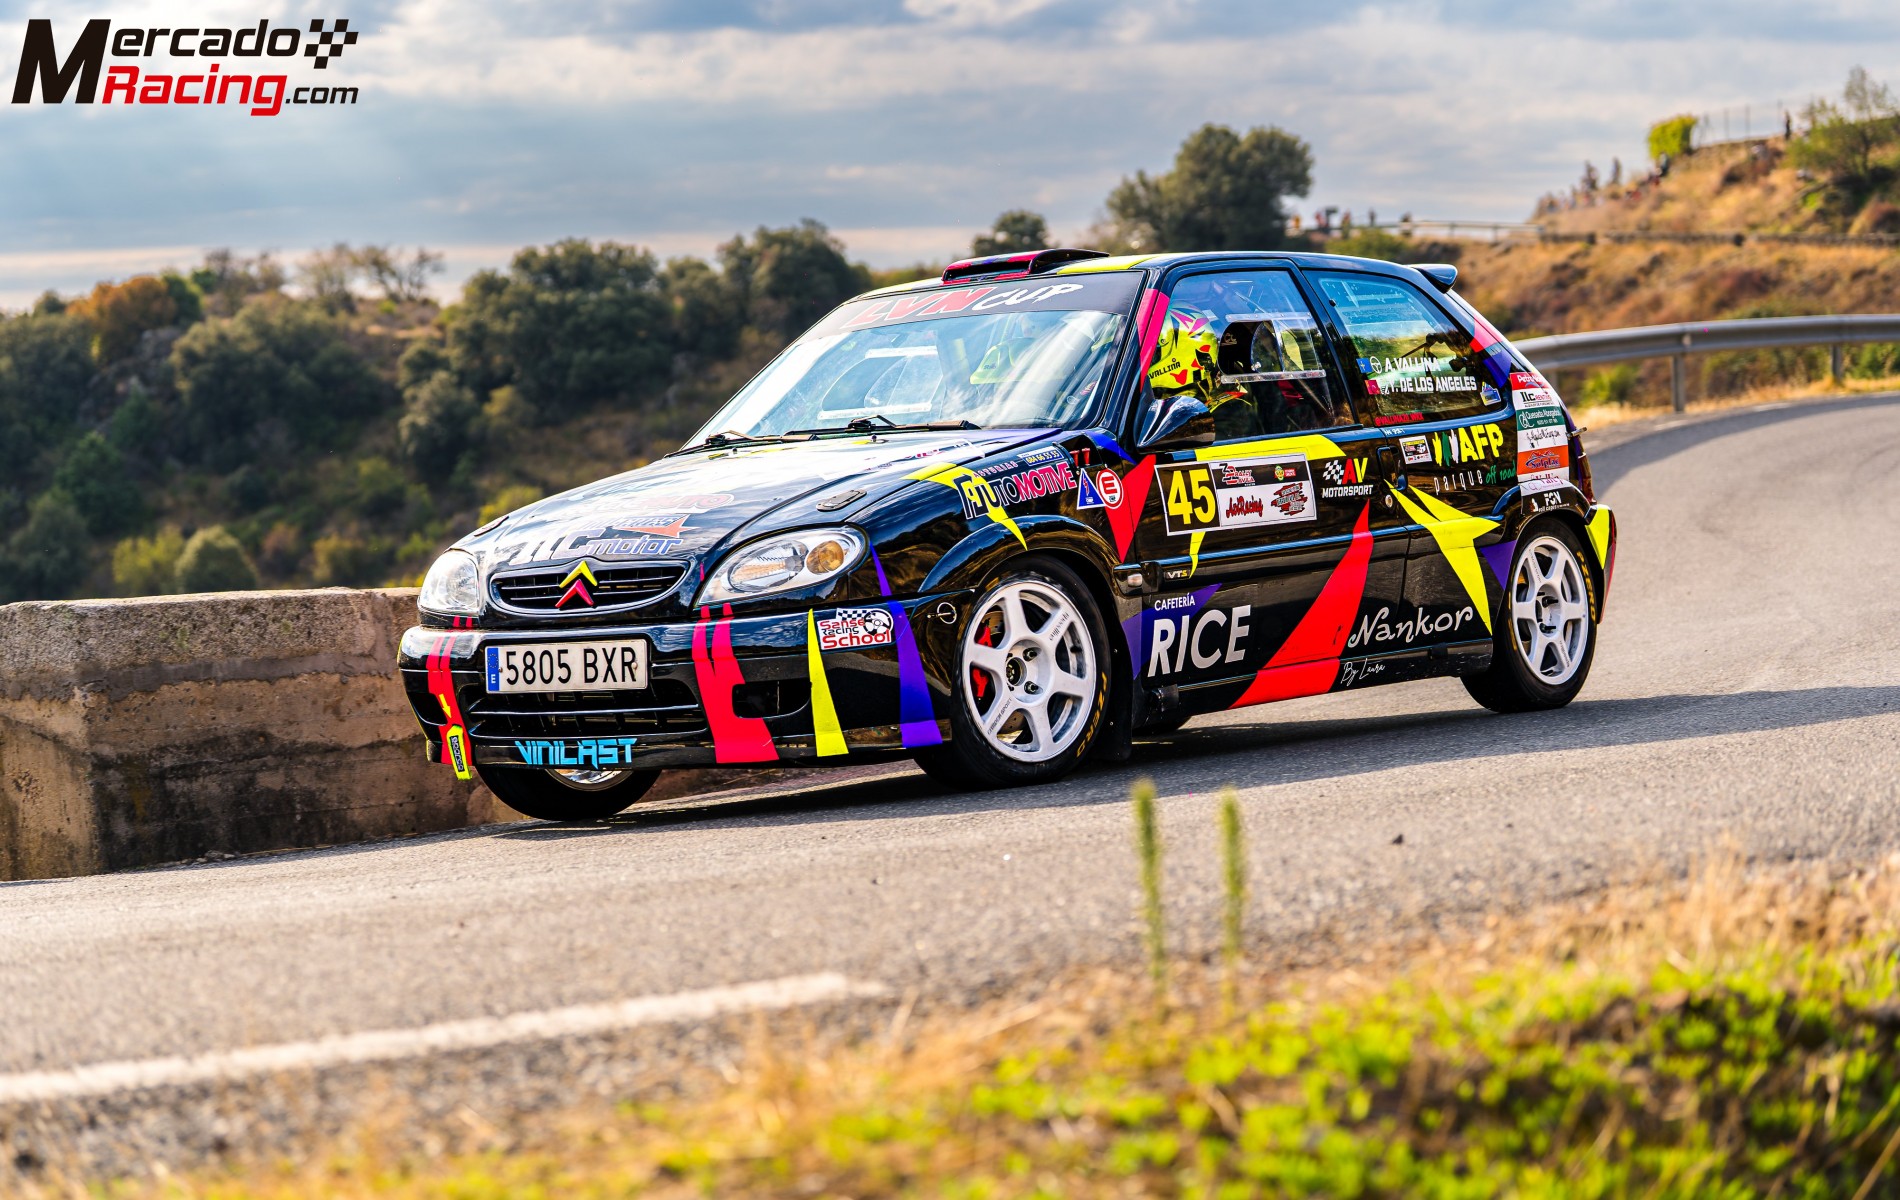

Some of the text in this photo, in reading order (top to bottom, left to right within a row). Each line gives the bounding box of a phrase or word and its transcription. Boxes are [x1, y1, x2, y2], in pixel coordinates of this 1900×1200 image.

[841, 283, 1084, 329] LVN CUP
[1400, 376, 1414, 392] DE
[1415, 376, 1434, 392] LOS
[1435, 376, 1478, 391] ANGELES
[1458, 423, 1504, 463] AFP
[973, 460, 1018, 478] ASTURIAS
[1341, 457, 1369, 484] AV
[1433, 459, 1517, 496] parque off road
[1101, 475, 1118, 495] E
[1167, 468, 1216, 525] 45
[1321, 484, 1374, 499] MOTORSPORT
[585, 534, 684, 555] motor
[1167, 569, 1188, 579] VTS
[1154, 592, 1196, 611] CAFETERÍA
[820, 618, 866, 630] Sanse
[1347, 606, 1474, 648] Nankor
[822, 629, 891, 648] School
[1147, 604, 1251, 677] RICE
[506, 647, 637, 685] 5805 BXR
[1341, 661, 1359, 687] By
[490, 673, 497, 684] E
[515, 738, 638, 770] VINILAST
